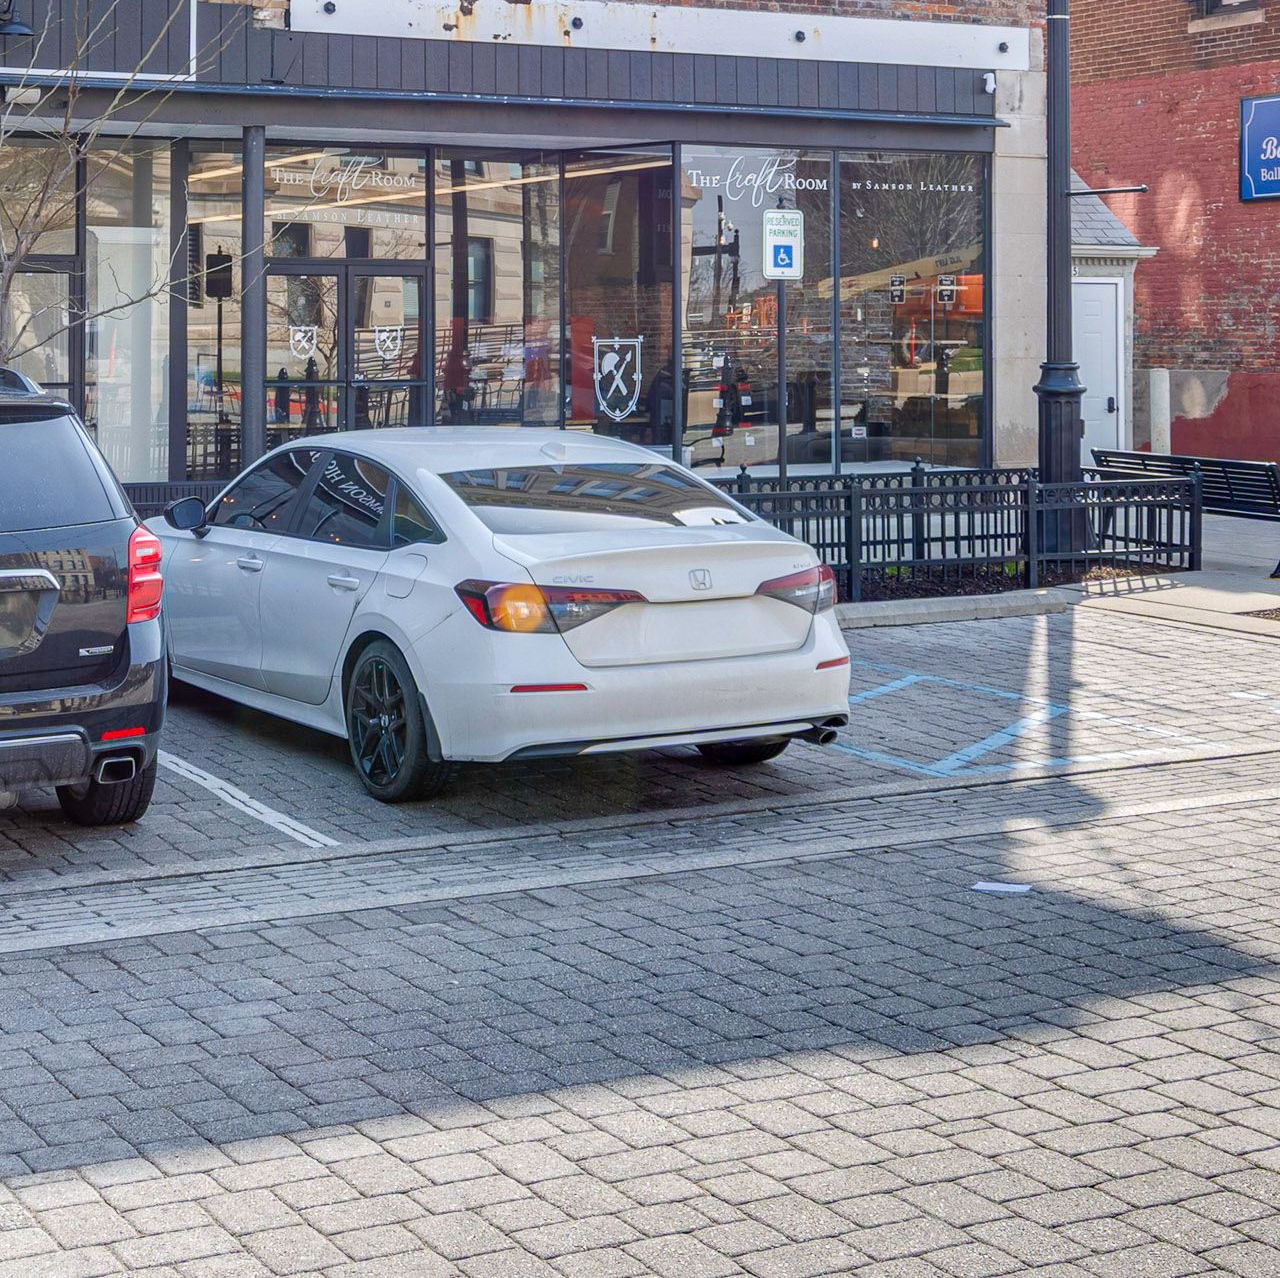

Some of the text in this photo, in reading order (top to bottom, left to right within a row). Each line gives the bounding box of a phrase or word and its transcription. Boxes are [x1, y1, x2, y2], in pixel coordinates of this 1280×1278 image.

[272, 167, 303, 183] THE
[372, 171, 416, 188] ROOM
[688, 170, 720, 187] THE
[784, 173, 828, 190] ROOM
[865, 180, 913, 190] SAMSON
[920, 182, 974, 192] LEATHER
[769, 228, 798, 237] PARKING
[552, 575, 594, 583] CIVIC
